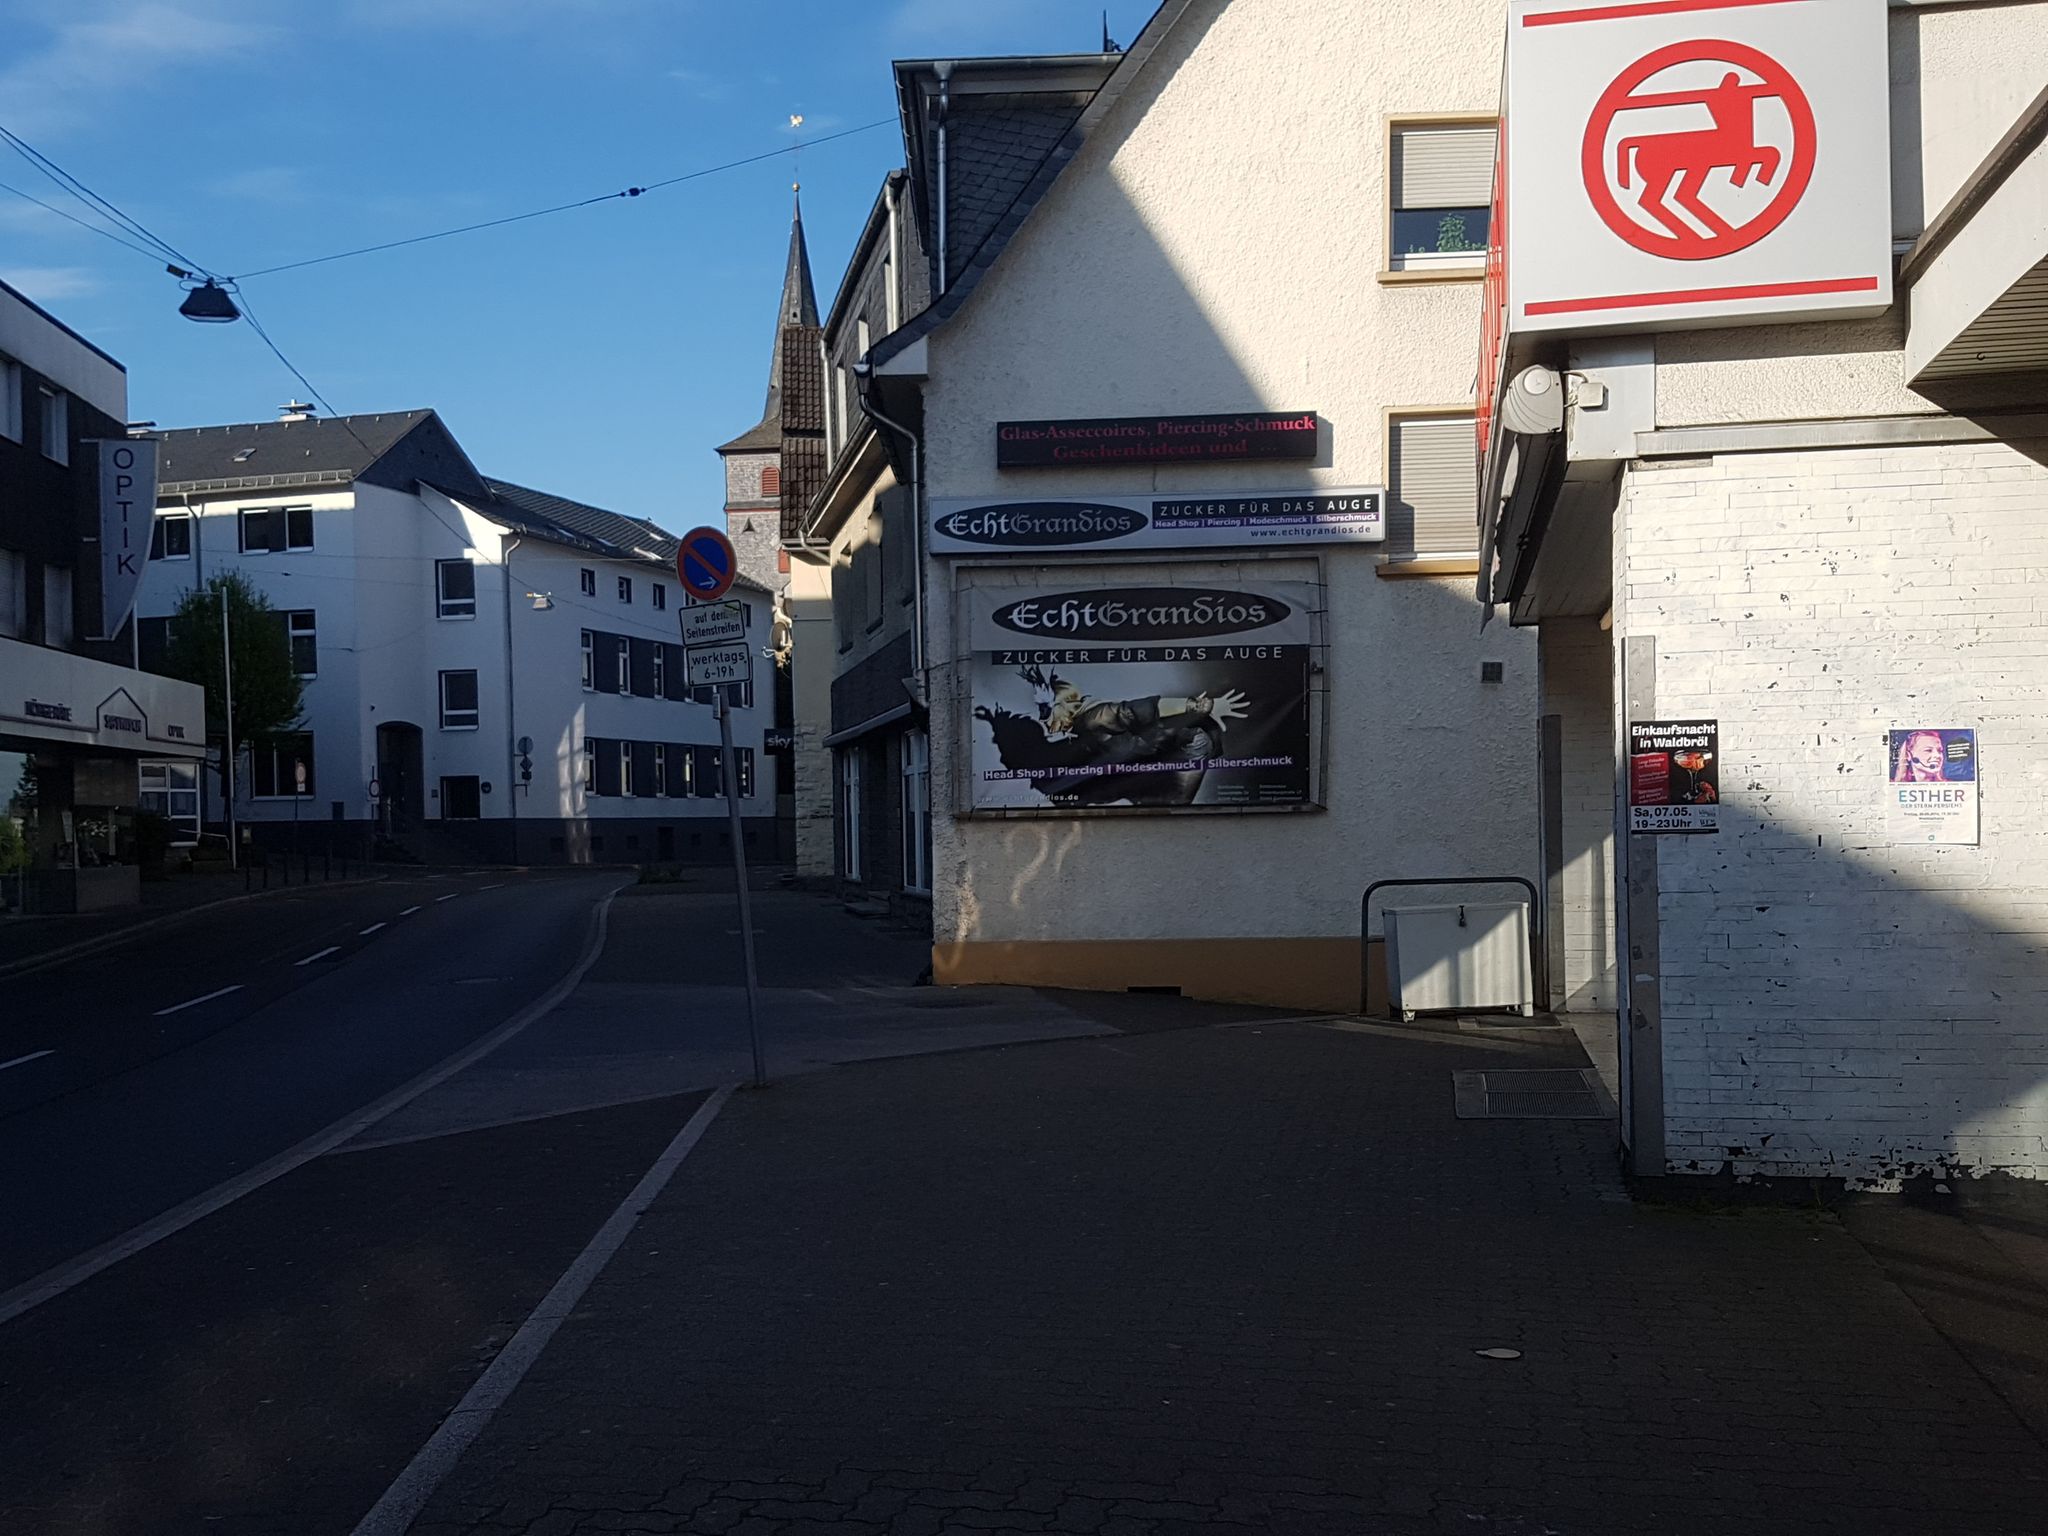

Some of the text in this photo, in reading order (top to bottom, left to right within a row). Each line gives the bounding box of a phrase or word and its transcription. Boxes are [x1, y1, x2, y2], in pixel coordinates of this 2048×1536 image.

[1157, 415, 1316, 437] Piercing-Schmuck
[1053, 441, 1204, 459] Geschenkideen
[1209, 439, 1249, 454] und
[113, 447, 137, 576] OPTIK
[1160, 499, 1372, 516] ZUCKER FÜR DAS AUGE
[944, 494, 1132, 538] EchtGrandios
[1155, 513, 1377, 528] Head Shop Piercing Modeschmuck Silberschmuck
[1250, 525, 1371, 537] www.echtgrandios.de
[694, 611, 708, 624] auf
[1007, 597, 1266, 632] EchtGrandios
[686, 622, 741, 639] Seitenstreifen
[691, 651, 745, 666] werktags
[1003, 646, 1283, 664] ZUCKER FÜR DAS AUGE
[1631, 723, 1717, 737] Einkaufsnacht
[767, 734, 792, 749] sky
[1639, 736, 1708, 748] in Waldbröl
[985, 755, 1293, 780] Head Shop Piercing Modeschmuck Silberschmuck
[1898, 789, 1965, 802] ESTHER
[1634, 808, 1653, 819] Sa,
[1654, 807, 1692, 818] 07.05.
[1671, 819, 1692, 829] Uhr
